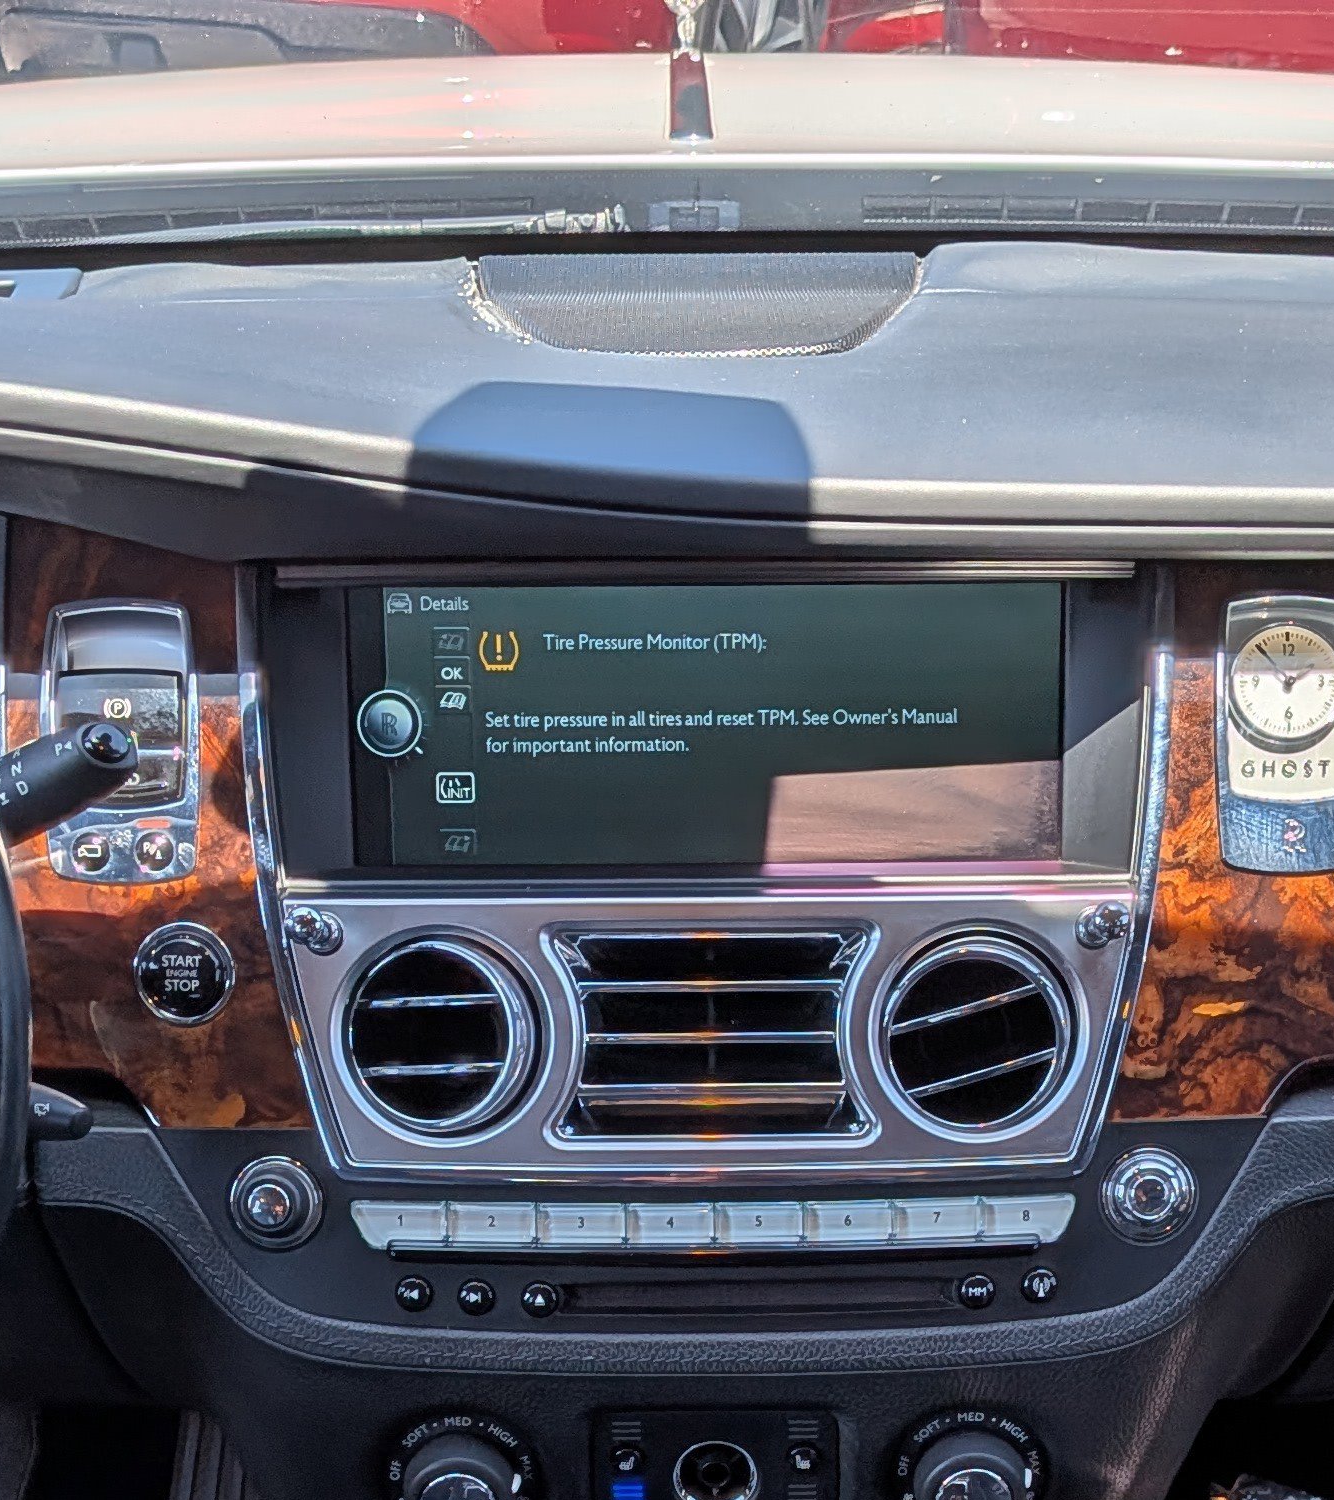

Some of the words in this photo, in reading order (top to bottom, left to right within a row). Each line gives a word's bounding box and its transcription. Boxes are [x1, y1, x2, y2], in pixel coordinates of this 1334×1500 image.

[420, 597, 469, 612] Details
[543, 634, 574, 650] Tire
[579, 634, 643, 650] Pressure
[647, 634, 709, 650] Monitor
[713, 633, 767, 653] (TPM):
[1283, 643, 1295, 657] 12
[441, 667, 463, 679] OK
[1252, 675, 1260, 690] 9
[1318, 675, 1325, 689] 3
[485, 711, 511, 728] Set
[514, 711, 540, 728] tire
[543, 713, 608, 731] pressure
[612, 711, 625, 726] in
[628, 710, 645, 726] all
[649, 710, 681, 726] tires
[685, 709, 713, 726] and
[716, 711, 754, 726] reset
[757, 709, 799, 725] TPM.
[802, 709, 829, 725] See
[833, 708, 898, 725] Owner's
[902, 708, 958, 724] Manual
[1285, 706, 1293, 721] 6
[486, 737, 509, 753] for
[512, 737, 591, 757] important
[595, 736, 690, 753] information.
[11, 762, 22, 776] N
[1241, 760, 1331, 778] GHOST
[15, 782, 29, 796] D
[447, 788, 471, 799] INIT
[162, 955, 202, 967] START
[166, 969, 197, 978] ENGINE
[164, 980, 200, 992] STOP
[397, 1215, 403, 1226] 1
[487, 1215, 496, 1228] 2
[577, 1216, 585, 1229] 3
[666, 1216, 674, 1229] 4
[755, 1215, 763, 1228] 5
[844, 1215, 852, 1227] 6
[933, 1211, 941, 1224] 7
[1022, 1210, 1030, 1222] 8
[444, 1416, 471, 1427] MED
[957, 1412, 984, 1422] MED
[402, 1423, 429, 1448] SOFT
[487, 1423, 518, 1448] HIGH
[914, 1419, 941, 1443] SOFT
[1000, 1418, 1028, 1443] HIGH
[519, 1455, 534, 1480] MAX
[898, 1455, 909, 1476] OFF
[1027, 1448, 1041, 1476] MAX
[389, 1460, 401, 1481] OFF
